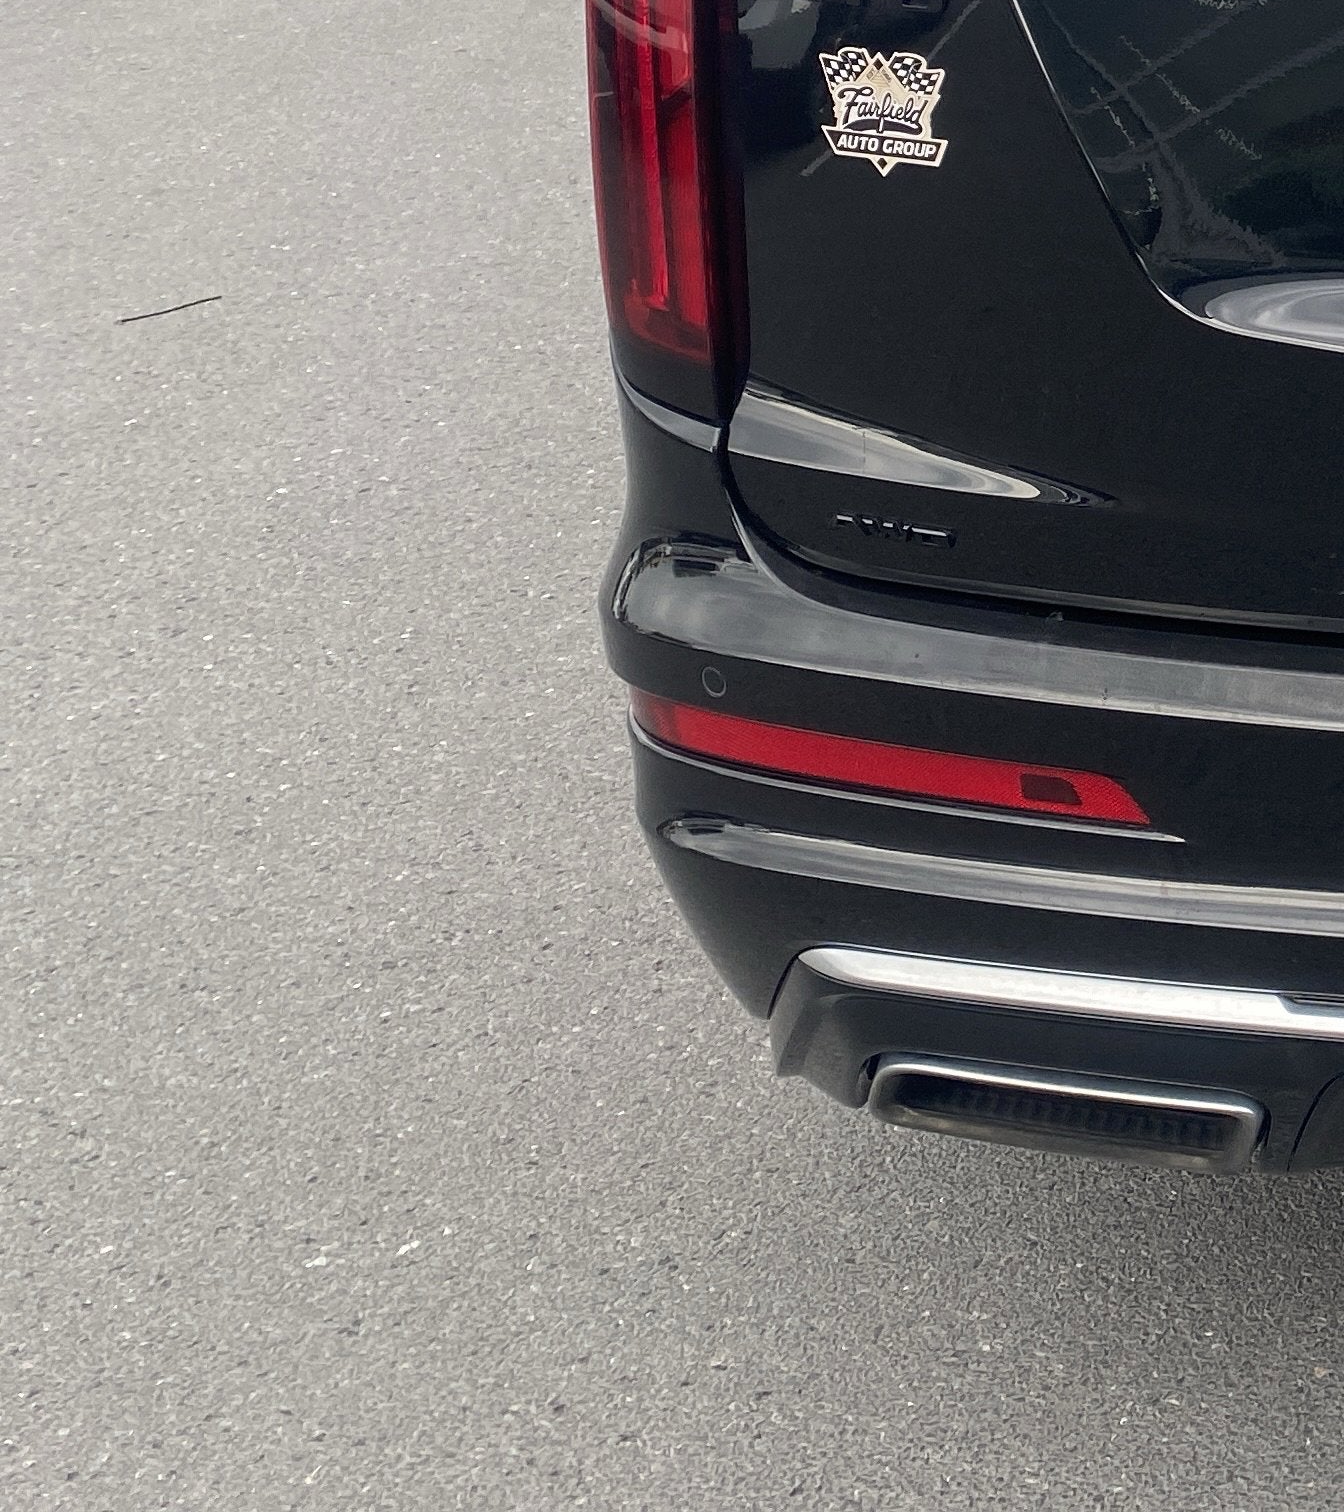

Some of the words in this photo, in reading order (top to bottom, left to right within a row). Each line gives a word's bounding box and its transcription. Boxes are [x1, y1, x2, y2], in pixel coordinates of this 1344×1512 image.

[837, 86, 929, 128] Fairfield
[836, 133, 879, 152] AUTO
[882, 138, 937, 158] GROUP
